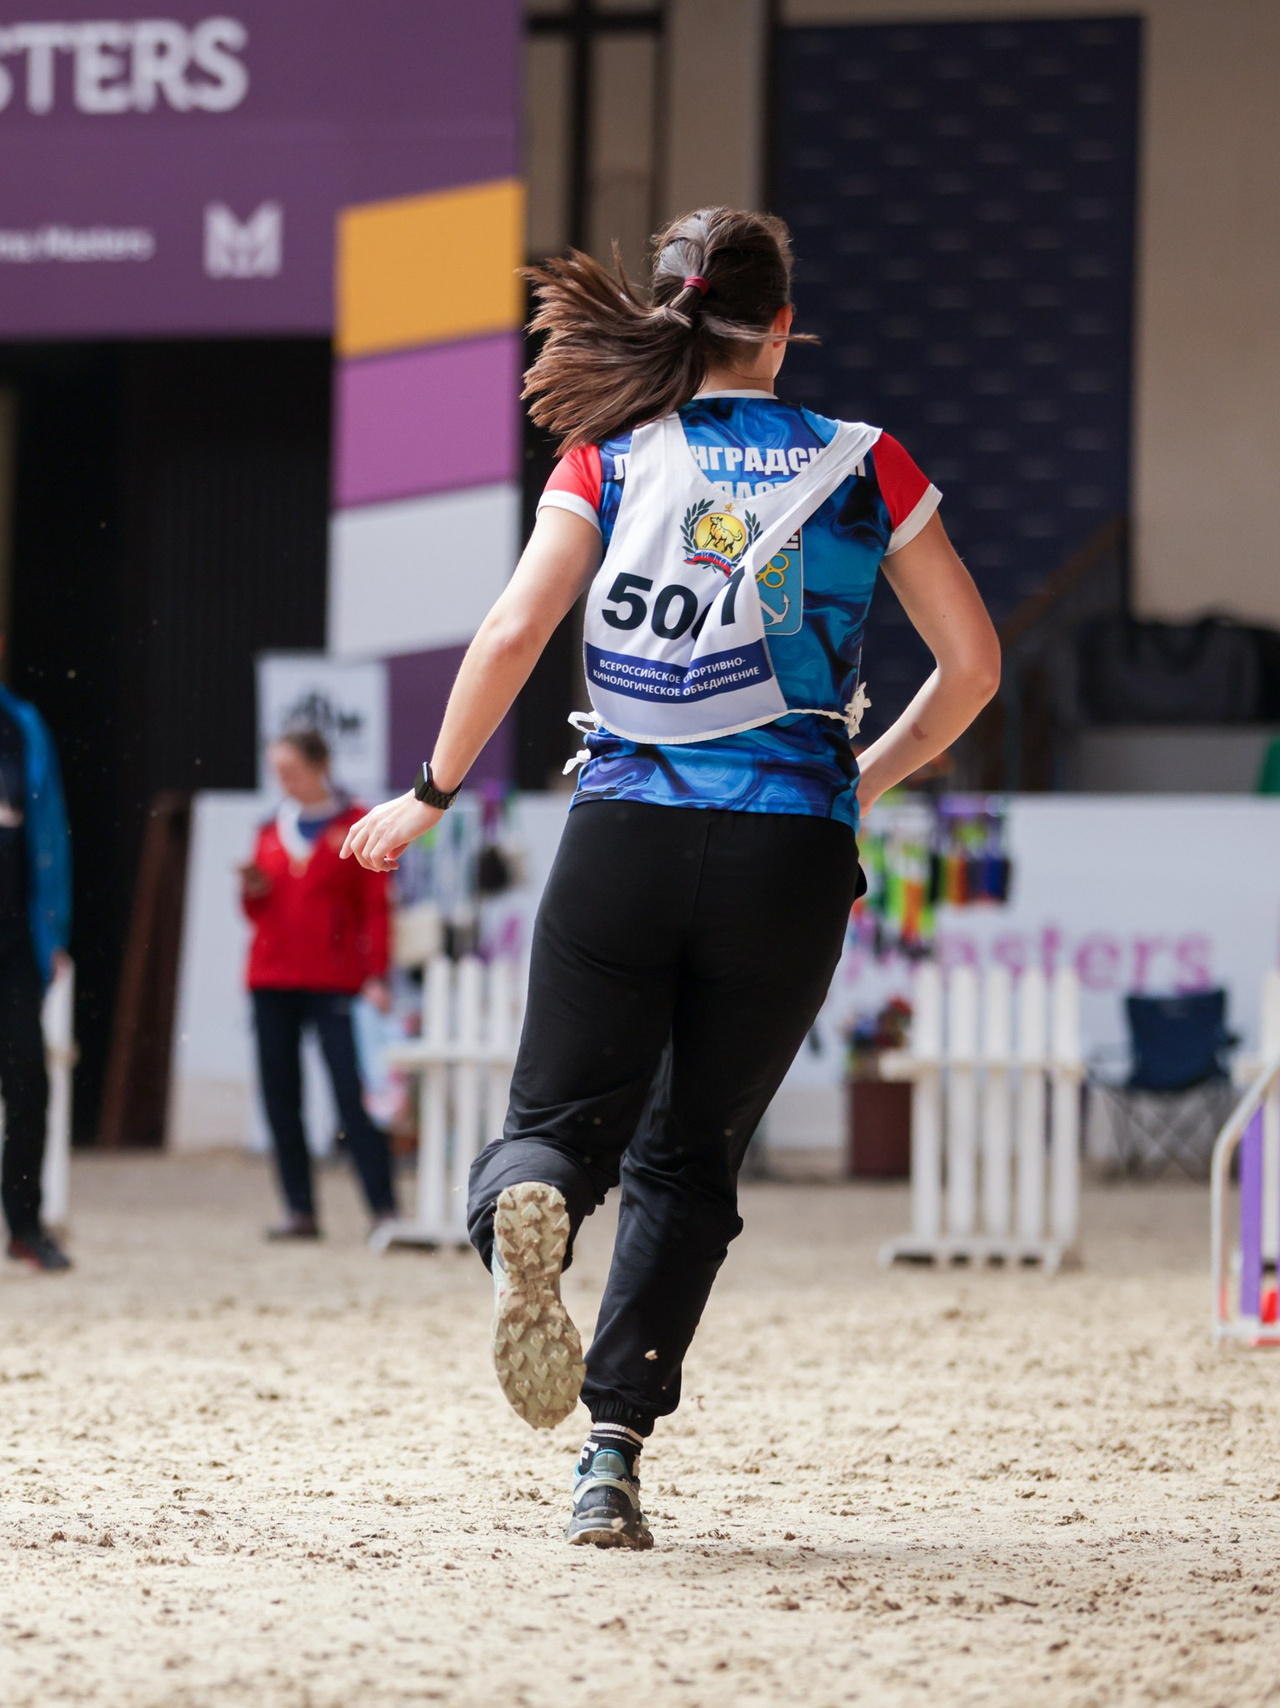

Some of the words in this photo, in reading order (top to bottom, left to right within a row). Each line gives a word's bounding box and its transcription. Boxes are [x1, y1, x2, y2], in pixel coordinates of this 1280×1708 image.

[592, 669, 681, 697] КИНОЛОГИЧЕСКОЕ
[682, 666, 760, 697] ОБЪЕДИНЕНИЕ
[600, 659, 681, 684] ВСЕРОССИЙСКОЕ
